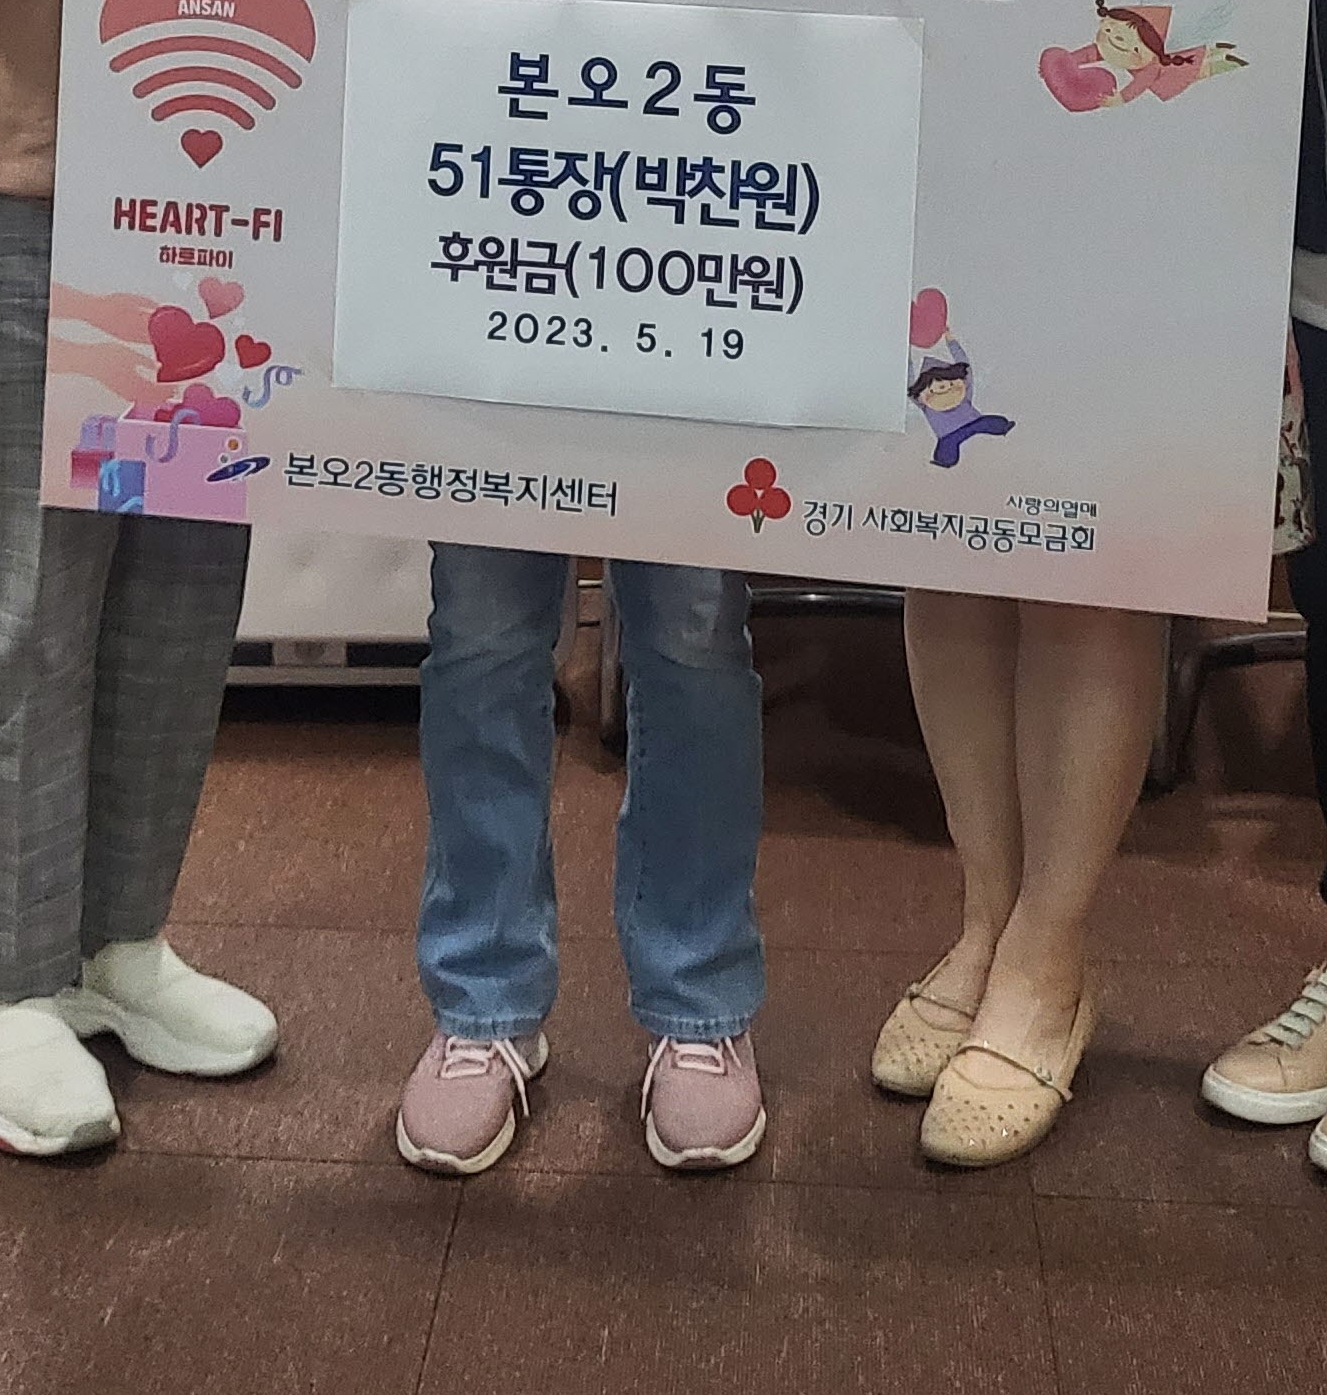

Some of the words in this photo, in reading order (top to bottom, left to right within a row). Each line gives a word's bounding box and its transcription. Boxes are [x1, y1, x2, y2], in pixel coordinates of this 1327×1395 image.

[427, 141, 821, 235] 51통장(박찬원)
[113, 196, 284, 243] HEART-FI
[430, 231, 805, 315] 후원금(100만원)
[701, 327, 744, 359] 19
[283, 451, 619, 517] 본오2동행정복지센터
[1006, 493, 1098, 519] 사랑의열매
[802, 500, 853, 536] 경기
[863, 507, 1096, 552] 사회복지공동모금회
